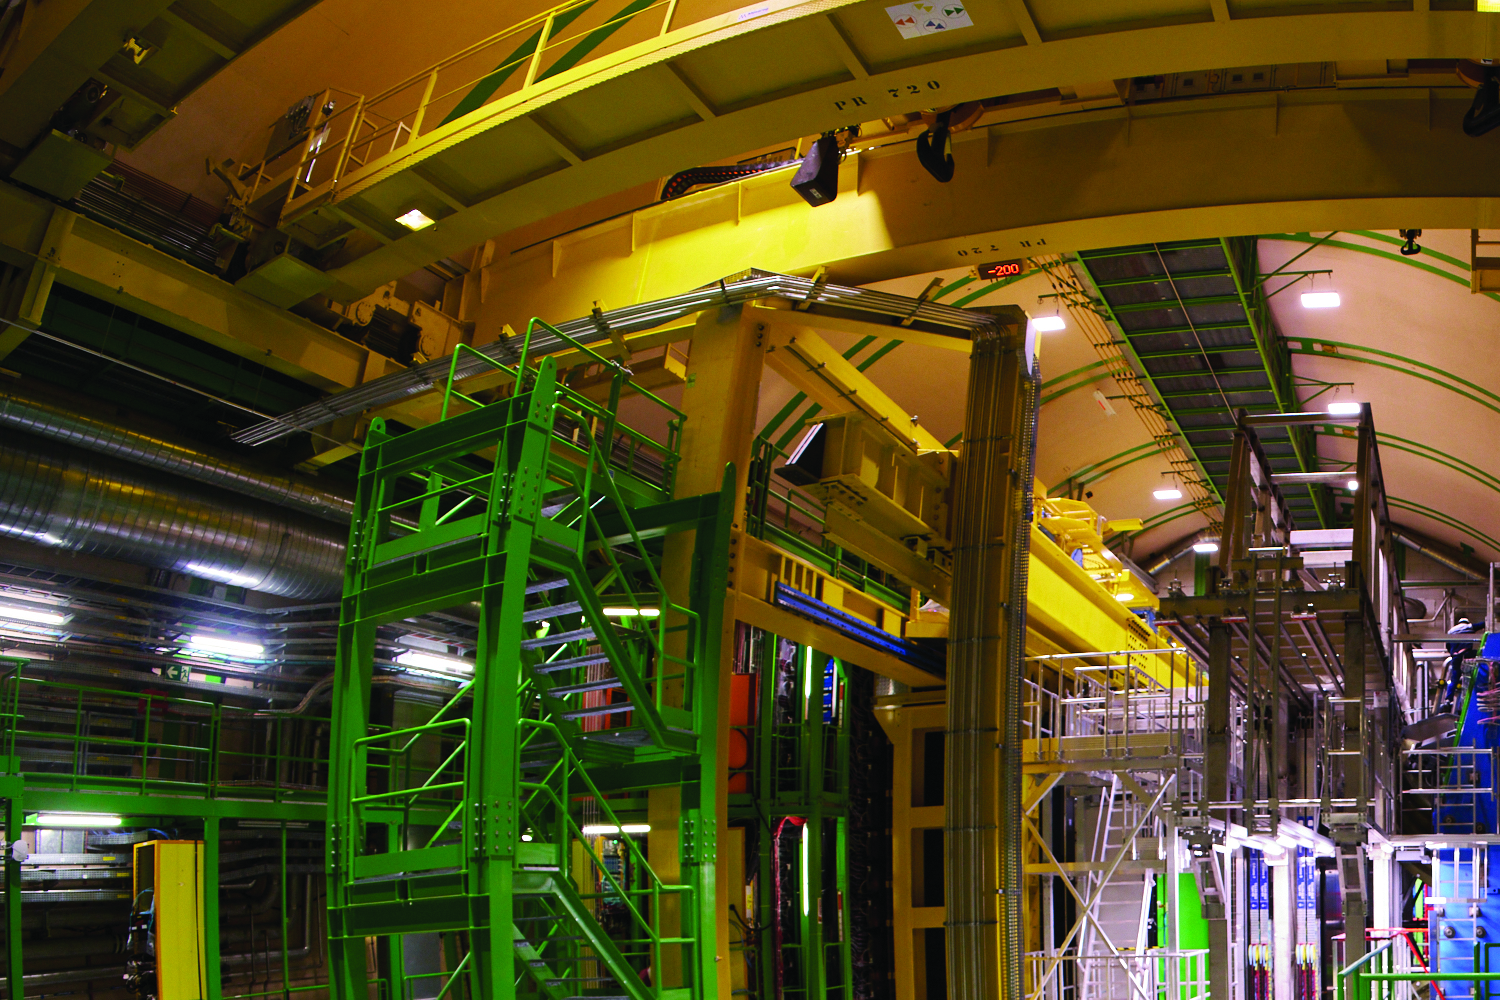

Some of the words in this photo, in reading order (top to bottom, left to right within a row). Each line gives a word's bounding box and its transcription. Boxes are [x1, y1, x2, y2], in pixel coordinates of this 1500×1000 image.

[834, 96, 868, 111] PR
[887, 80, 940, 98] 720
[1019, 238, 1047, 248] PR
[957, 244, 1000, 257] 720
[987, 263, 1020, 277] -200
